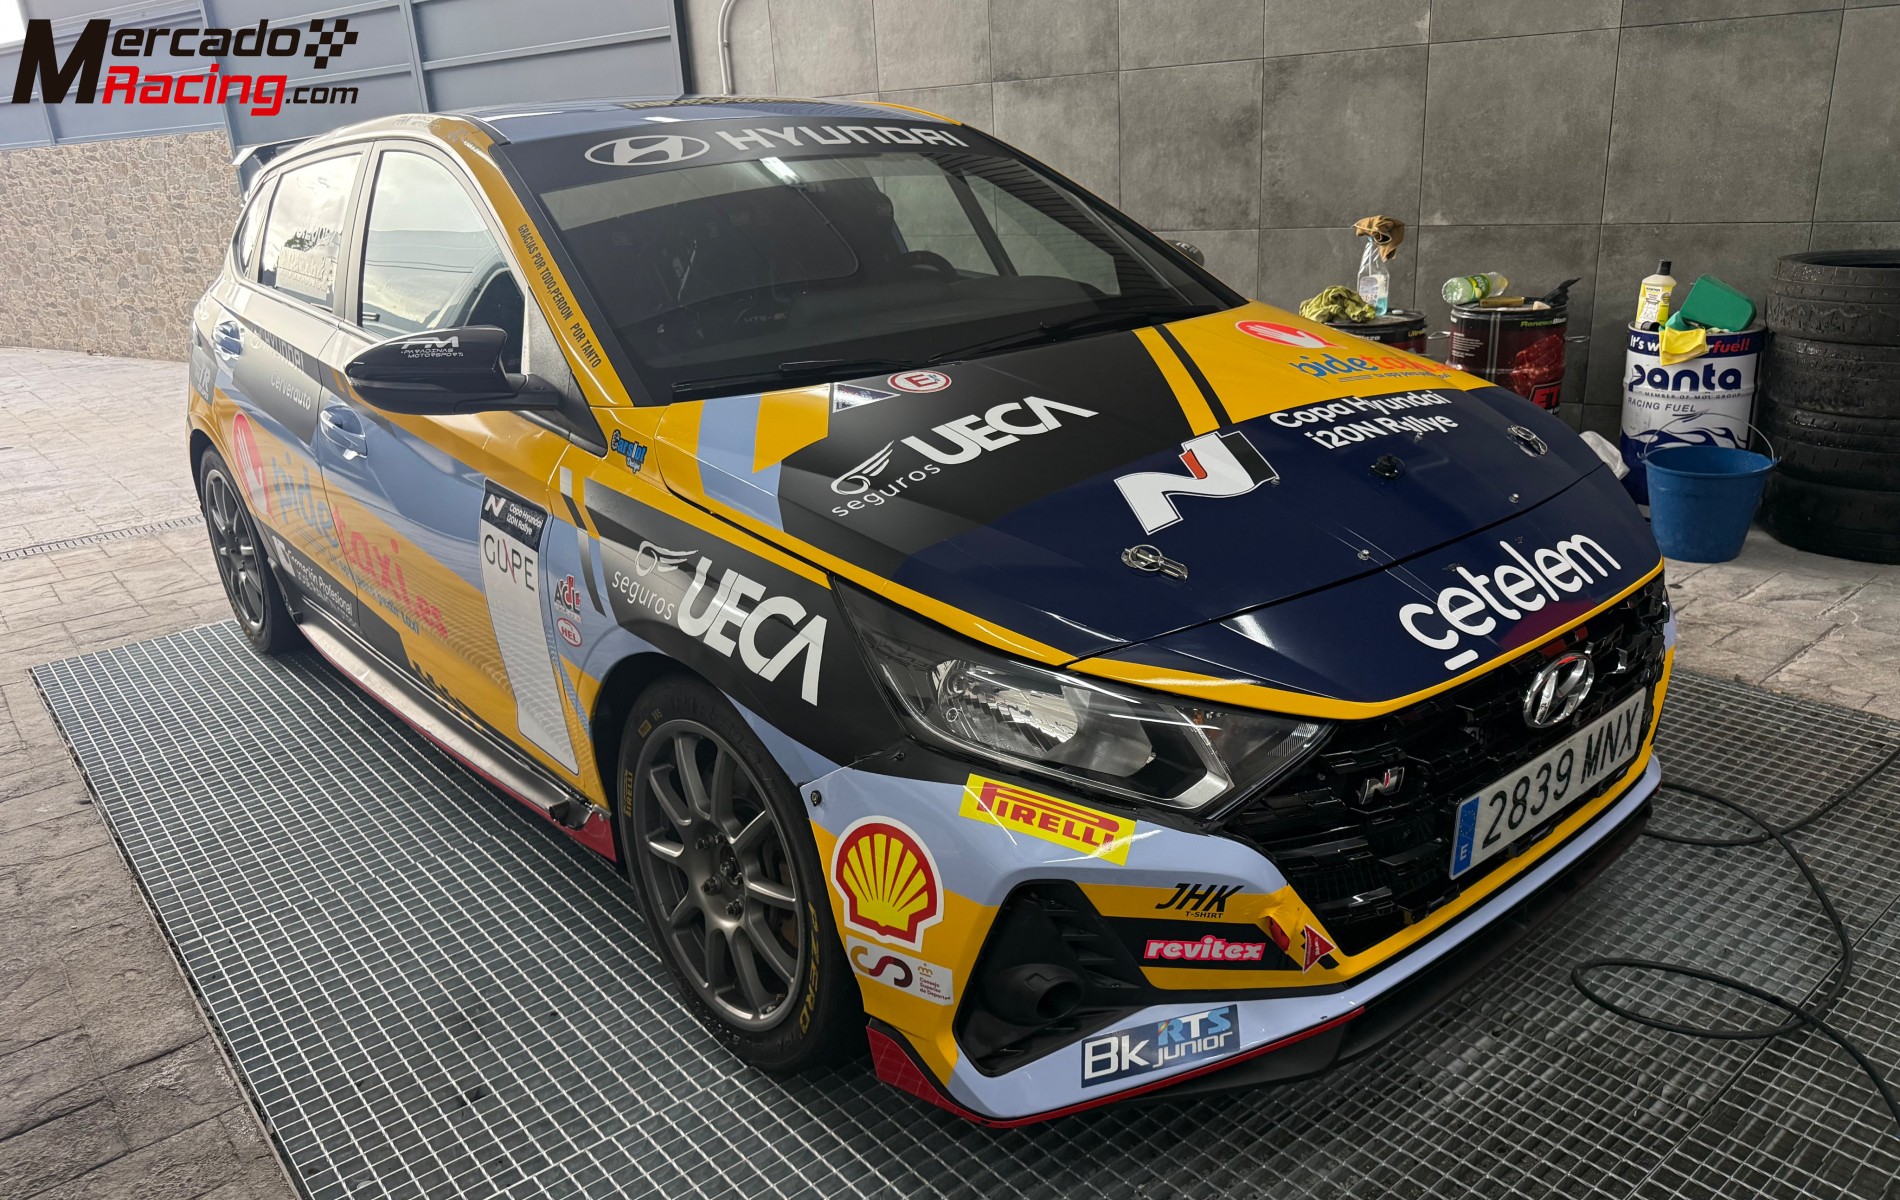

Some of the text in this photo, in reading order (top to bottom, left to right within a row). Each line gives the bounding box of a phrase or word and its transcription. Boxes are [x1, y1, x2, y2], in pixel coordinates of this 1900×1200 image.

[715, 125, 970, 151] HYUNDAI
[518, 223, 540, 255] GRACIAS
[532, 253, 547, 271] POR
[570, 322, 586, 343] POR
[580, 340, 602, 369] TANTO
[1630, 335, 1645, 350] It's
[271, 371, 311, 411] Cerverauto
[905, 374, 939, 388] E
[1628, 363, 1742, 392] panta
[1270, 390, 1452, 428] Copa Hyundai
[1628, 397, 1697, 412] RACING FUEL
[901, 396, 1099, 465] UECA
[1304, 414, 1458, 450] i20N Rallye
[831, 462, 941, 517] seguros
[509, 503, 544, 529] Copa Hyundai
[518, 519, 533, 536] Rallye
[318, 574, 353, 617] Profesional
[612, 571, 675, 620] seguros
[561, 626, 578, 644] HEL
[677, 556, 828, 707] UECA
[624, 768, 634, 818] PIRELLI
[1482, 702, 1640, 850] 2839 MNX
[976, 781, 1120, 852] PIRELLI
[1458, 843, 1468, 861] E
[1155, 883, 1244, 913] JHK
[1185, 911, 1223, 919] T-SHIRT
[1144, 935, 1266, 961] revitex
[920, 977, 940, 989] Consejo
[920, 983, 941, 994] Superior
[1158, 1007, 1232, 1046] RTS
[1085, 1035, 1150, 1080] Bk
[1153, 1032, 1233, 1068] junior
